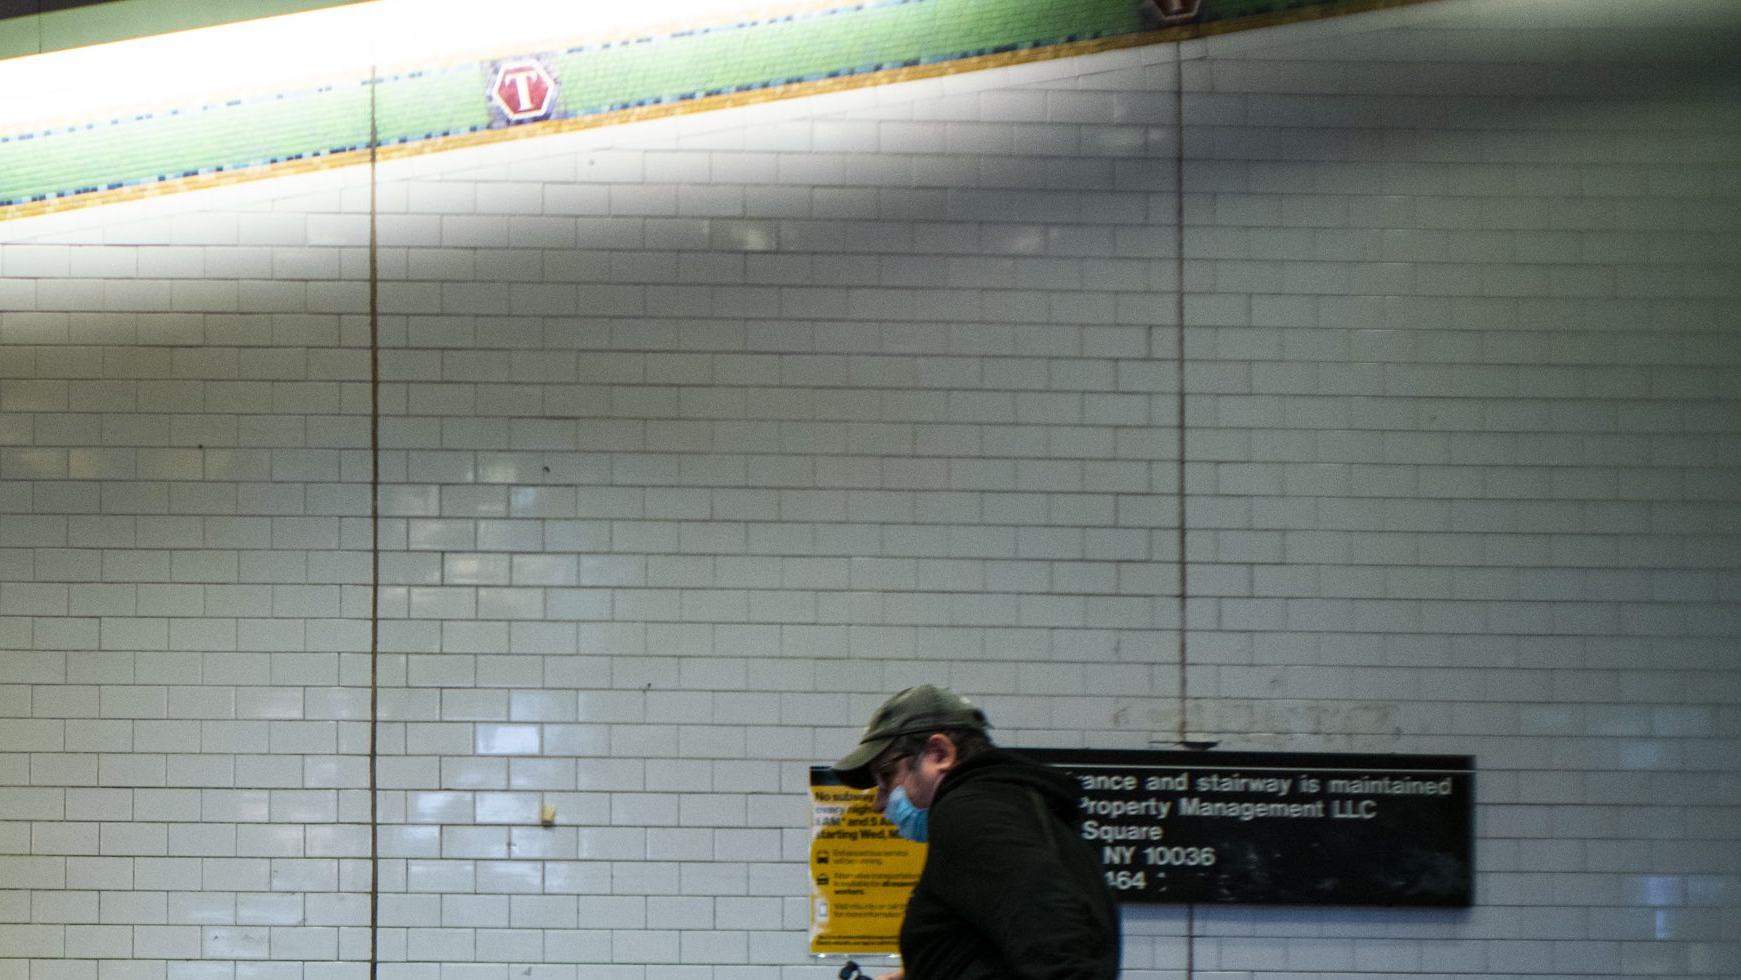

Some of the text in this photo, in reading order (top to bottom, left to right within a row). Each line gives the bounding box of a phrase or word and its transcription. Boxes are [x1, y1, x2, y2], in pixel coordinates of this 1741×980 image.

[503, 69, 539, 111] T
[1077, 772, 1453, 796] ance and stairway is maintained
[814, 792, 831, 801] No
[1177, 797, 1326, 821] Management
[1333, 799, 1378, 819] LLC
[1082, 820, 1164, 843] Square
[1102, 846, 1216, 866] NY 10036
